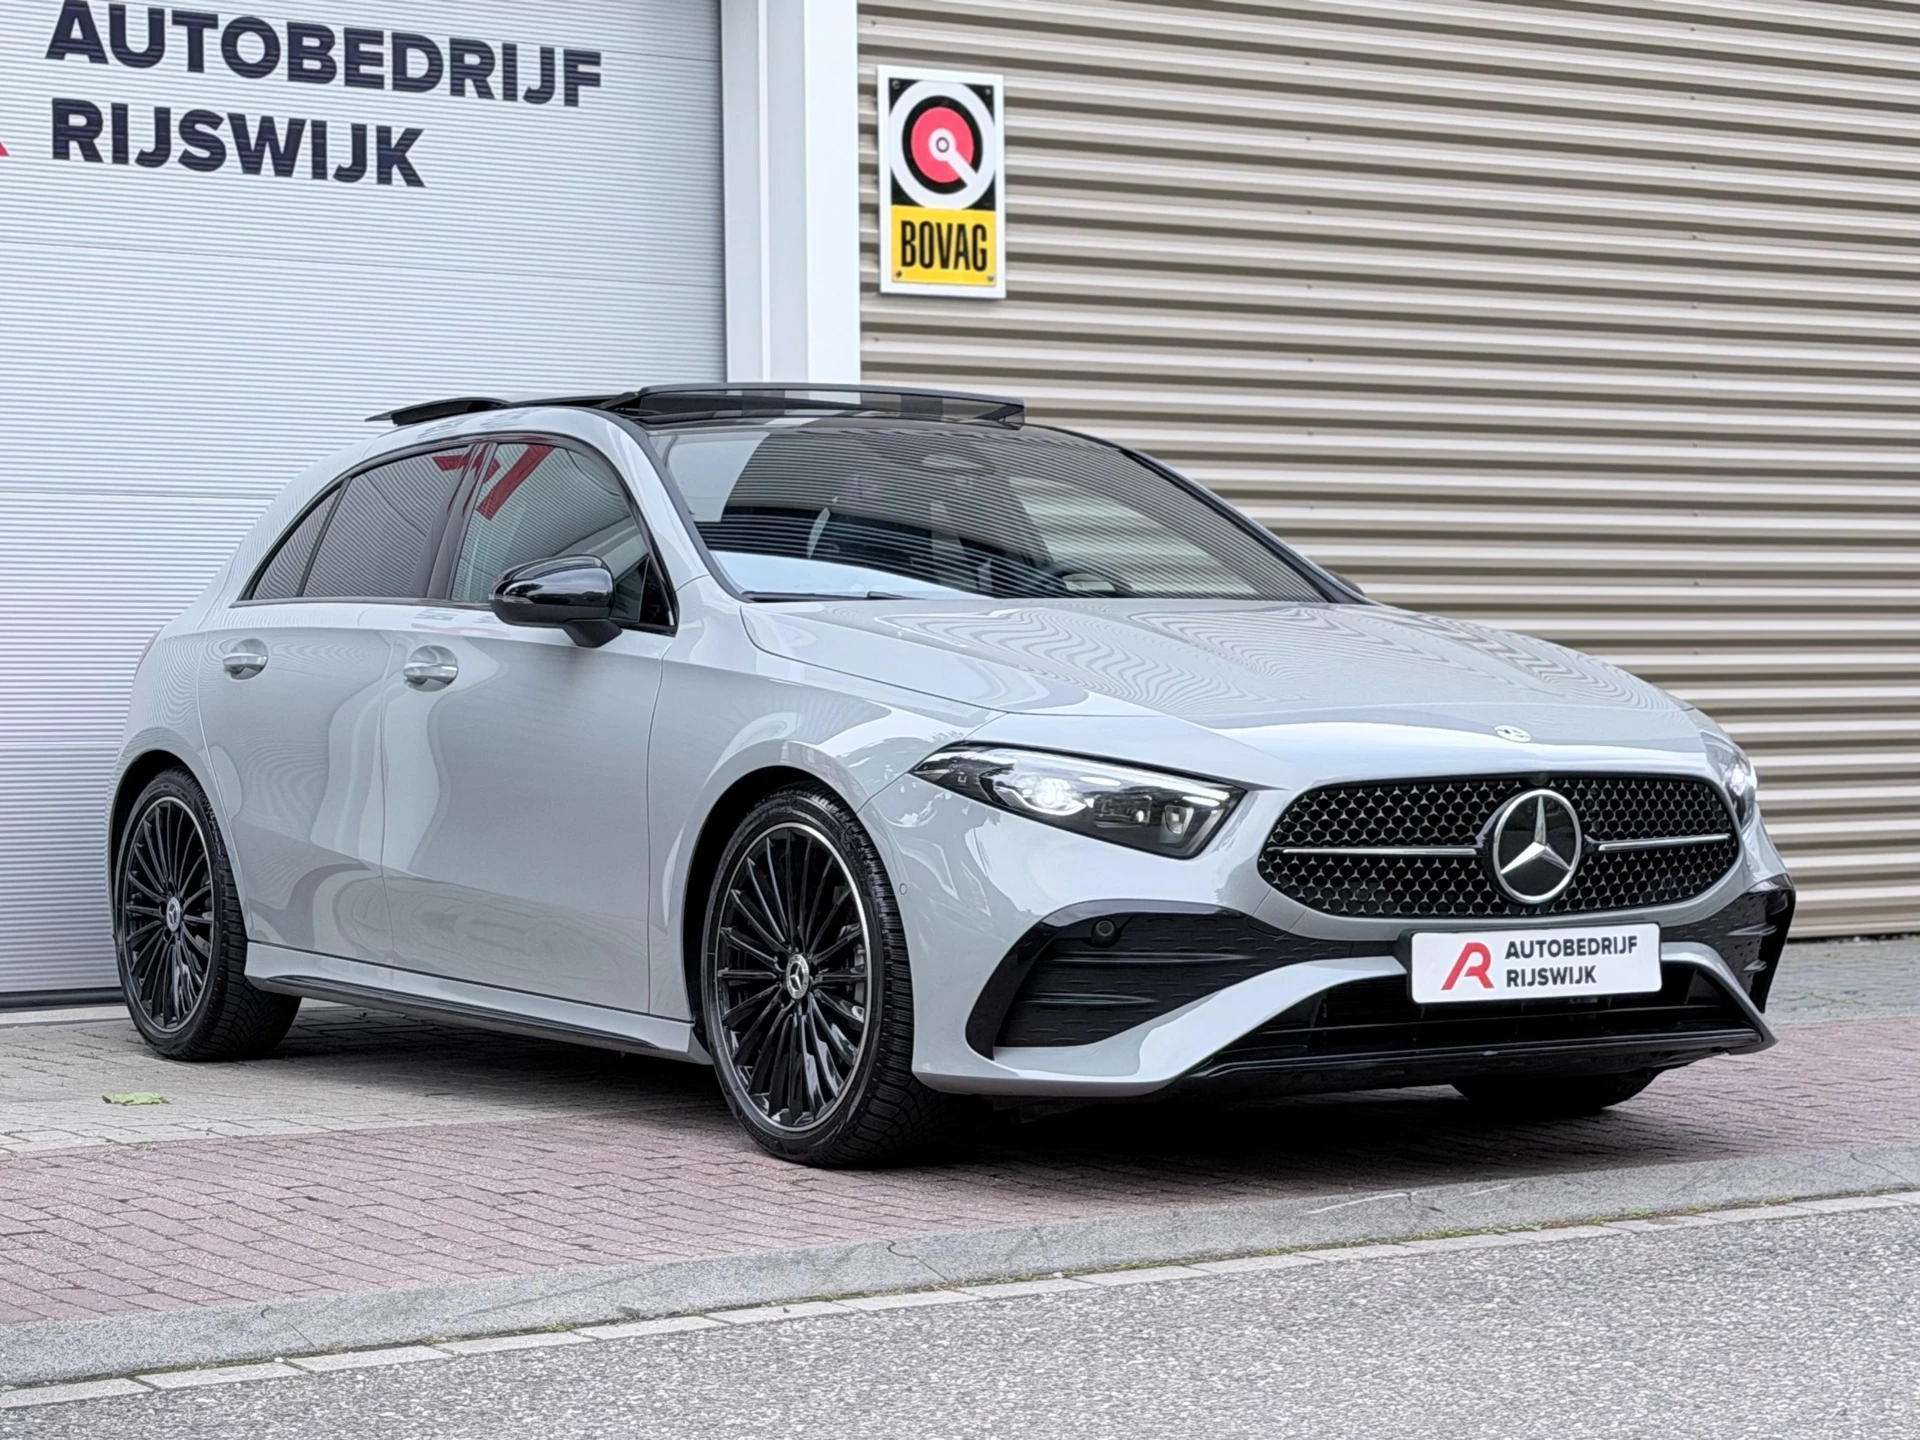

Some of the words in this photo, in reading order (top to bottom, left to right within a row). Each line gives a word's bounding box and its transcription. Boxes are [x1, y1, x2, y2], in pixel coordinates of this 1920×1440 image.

[45, 0, 602, 108] AUTOBEDRIJF
[51, 97, 426, 188] RIJSWIJK
[901, 220, 987, 272] BOVAG
[1505, 935, 1638, 960] AUTOBEDRIJF
[1506, 965, 1597, 988] RIJSWIJK
